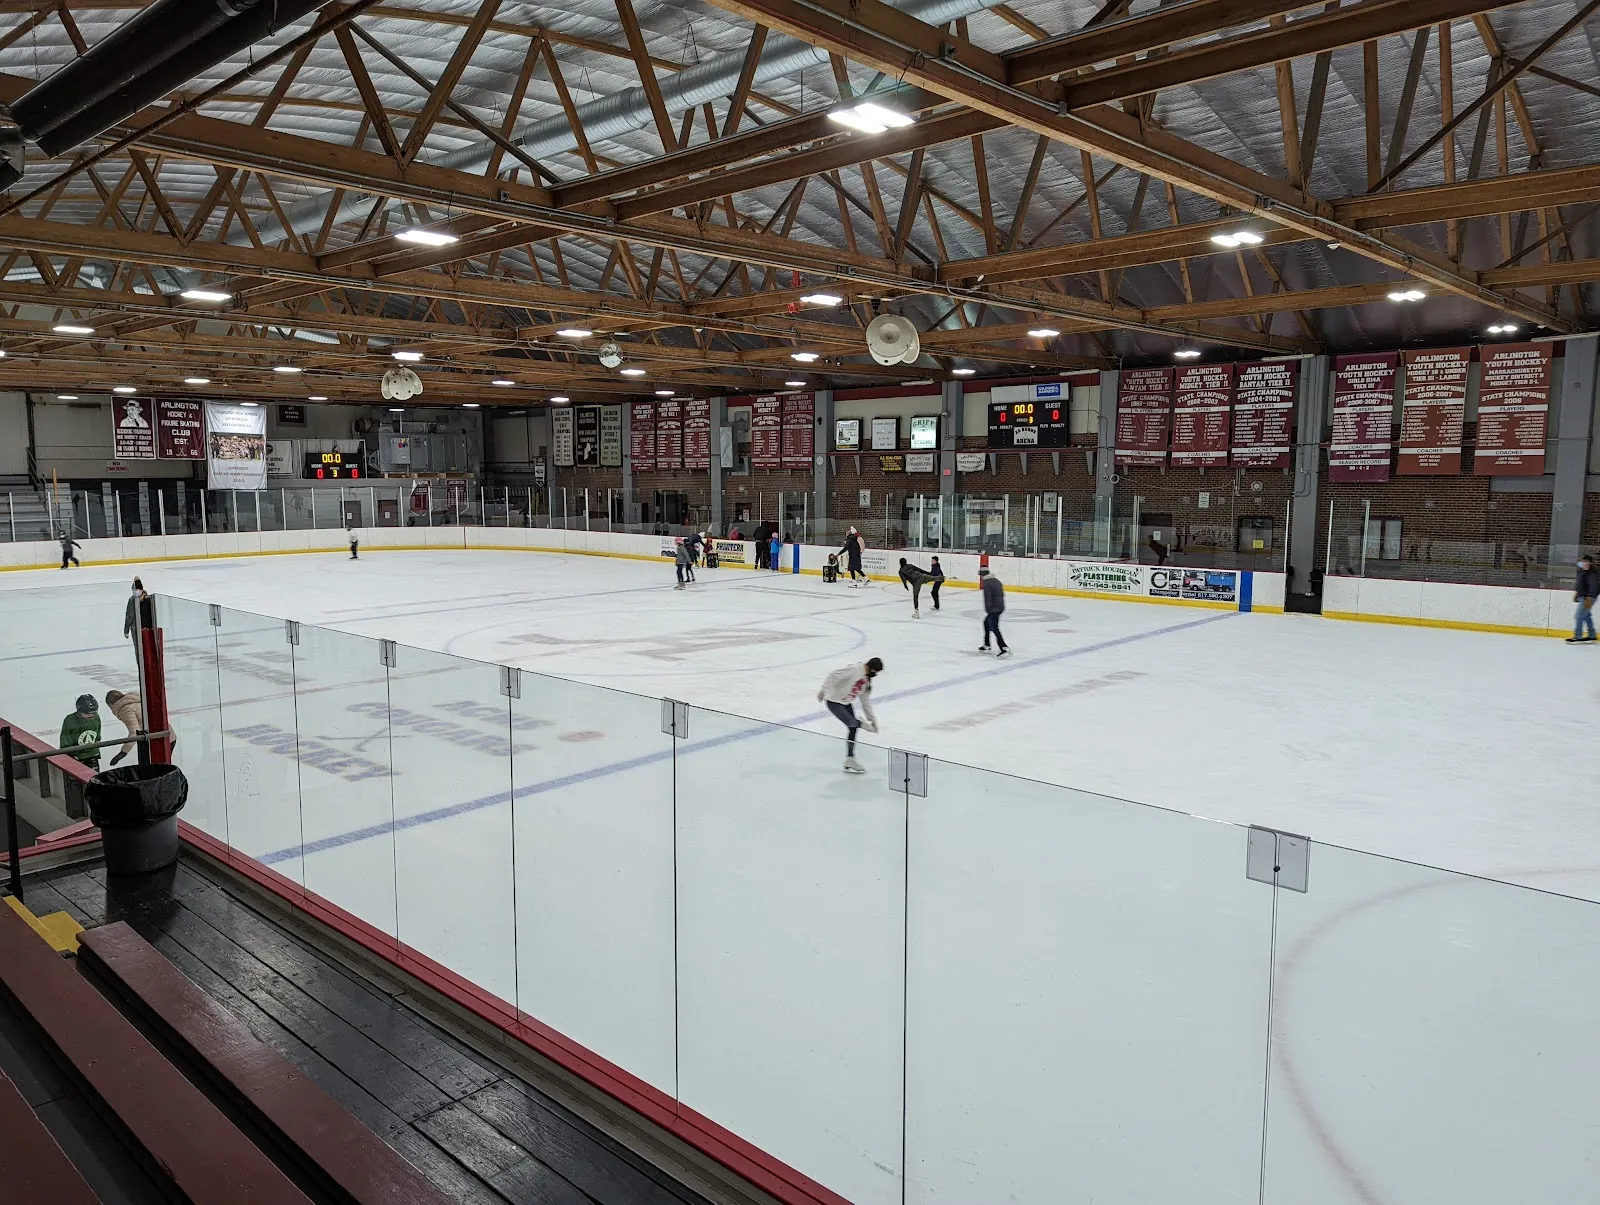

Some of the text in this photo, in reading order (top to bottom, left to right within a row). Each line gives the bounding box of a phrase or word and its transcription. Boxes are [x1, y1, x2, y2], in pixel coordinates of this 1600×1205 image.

[1493, 351, 1540, 359] ARLINGTON
[1246, 365, 1285, 373] ARLINGTON
[1345, 363, 1387, 371] ARLINGTON
[1237, 390, 1256, 399] STATE
[1406, 386, 1425, 394] STATE
[1177, 391, 1229, 403] STATE CHAMPIONS
[1336, 394, 1355, 402] STATE
[1482, 392, 1503, 401] STATE
[161, 402, 199, 410] ARLINGTON
[1014, 404, 1033, 414] 00.0
[1000, 413, 1006, 421] 0
[1053, 410, 1058, 419] 0
[322, 454, 341, 463] 00.0
[317, 469, 323, 478] 0
[352, 469, 358, 477] 0
[1102, 566, 1138, 577] HOURICAN
[1084, 573, 1126, 581] PLASTERING
[345, 702, 540, 756] COUGARS
[222, 724, 403, 782] HOCKEY
